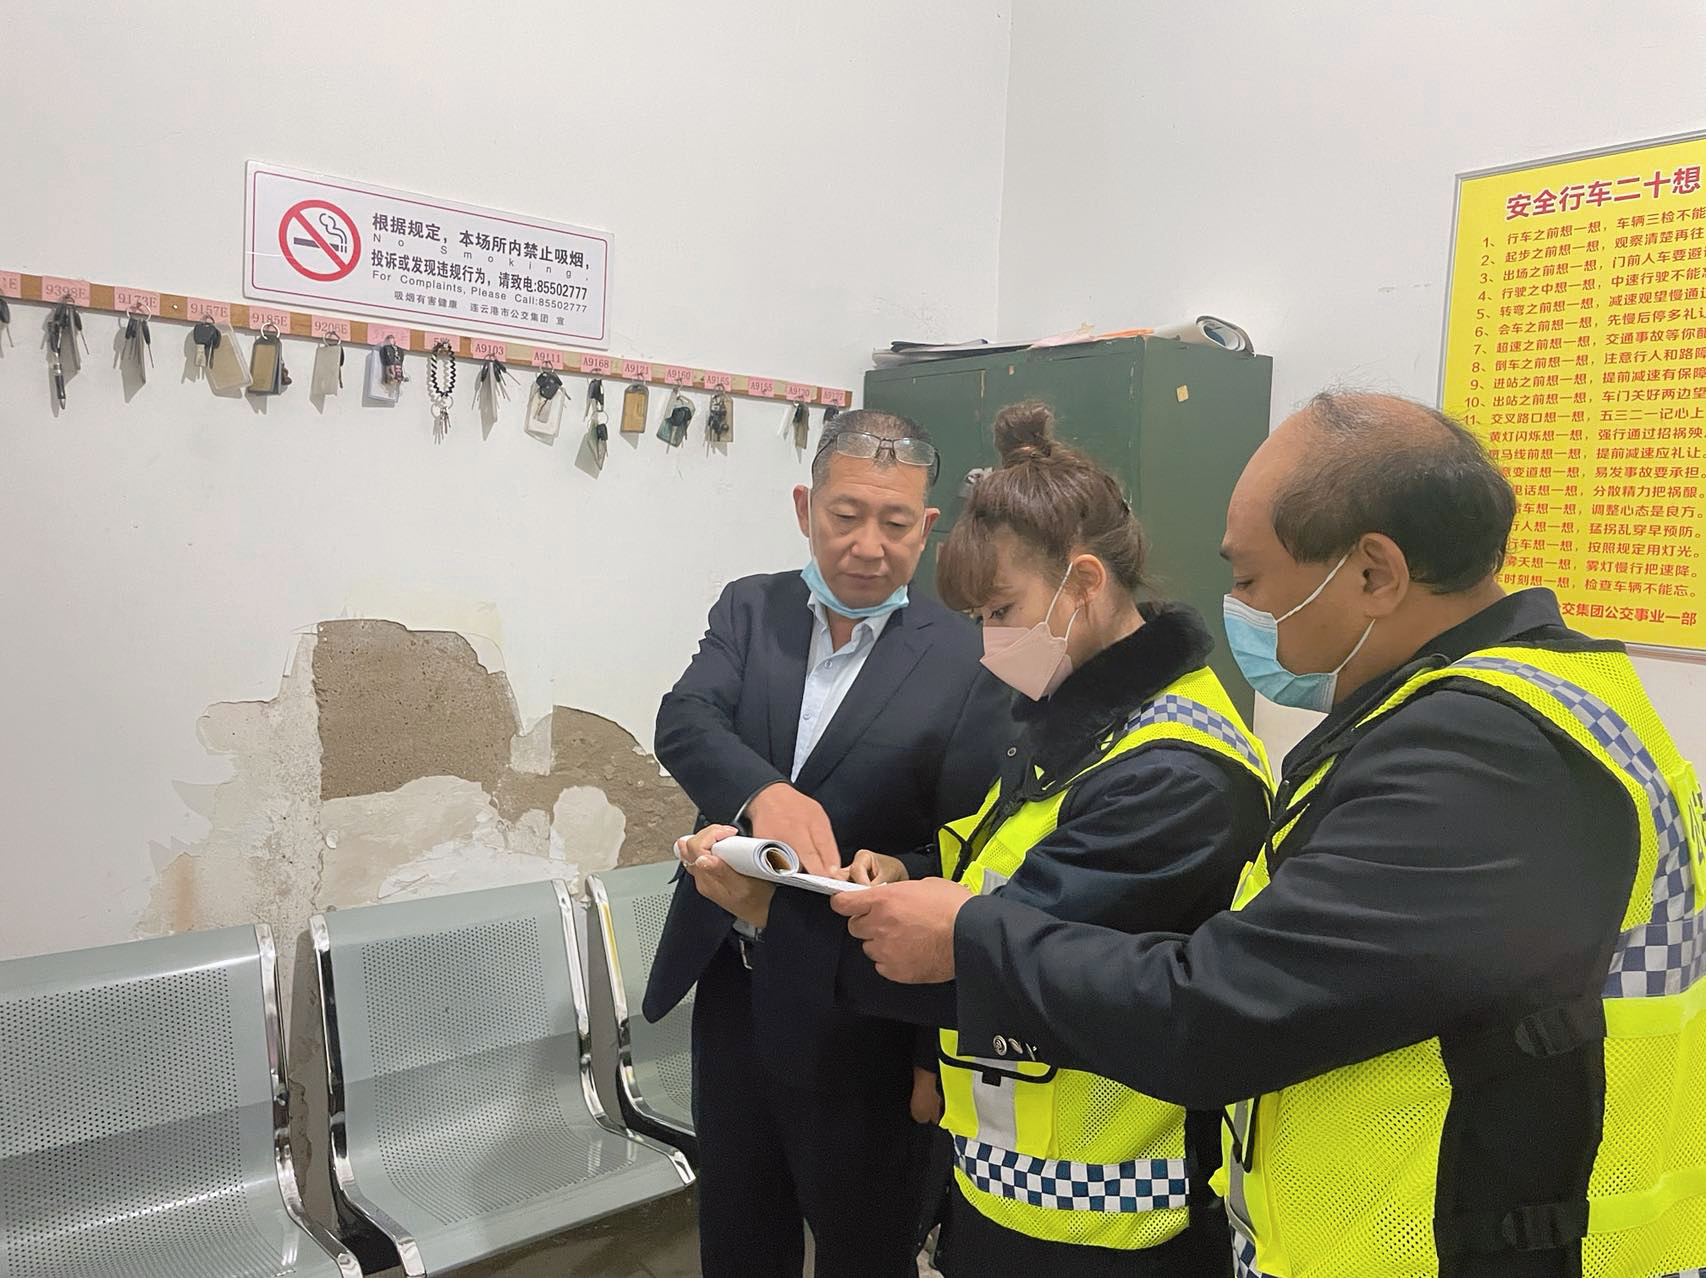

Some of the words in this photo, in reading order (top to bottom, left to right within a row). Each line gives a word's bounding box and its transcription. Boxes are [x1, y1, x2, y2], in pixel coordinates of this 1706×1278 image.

[1506, 166, 1701, 220] 安全行车二十想
[372, 270, 391, 281] For
[400, 274, 467, 295] Complaints,
[471, 286, 506, 300] Please
[190, 303, 229, 318] 9157E
[394, 291, 457, 309] 吸烟有害健康
[470, 303, 549, 324] 连云港市公交集团
[475, 344, 504, 356] A9103
[583, 357, 610, 368] A9168
[1558, 602, 1697, 626] 交集团公交事业一部
